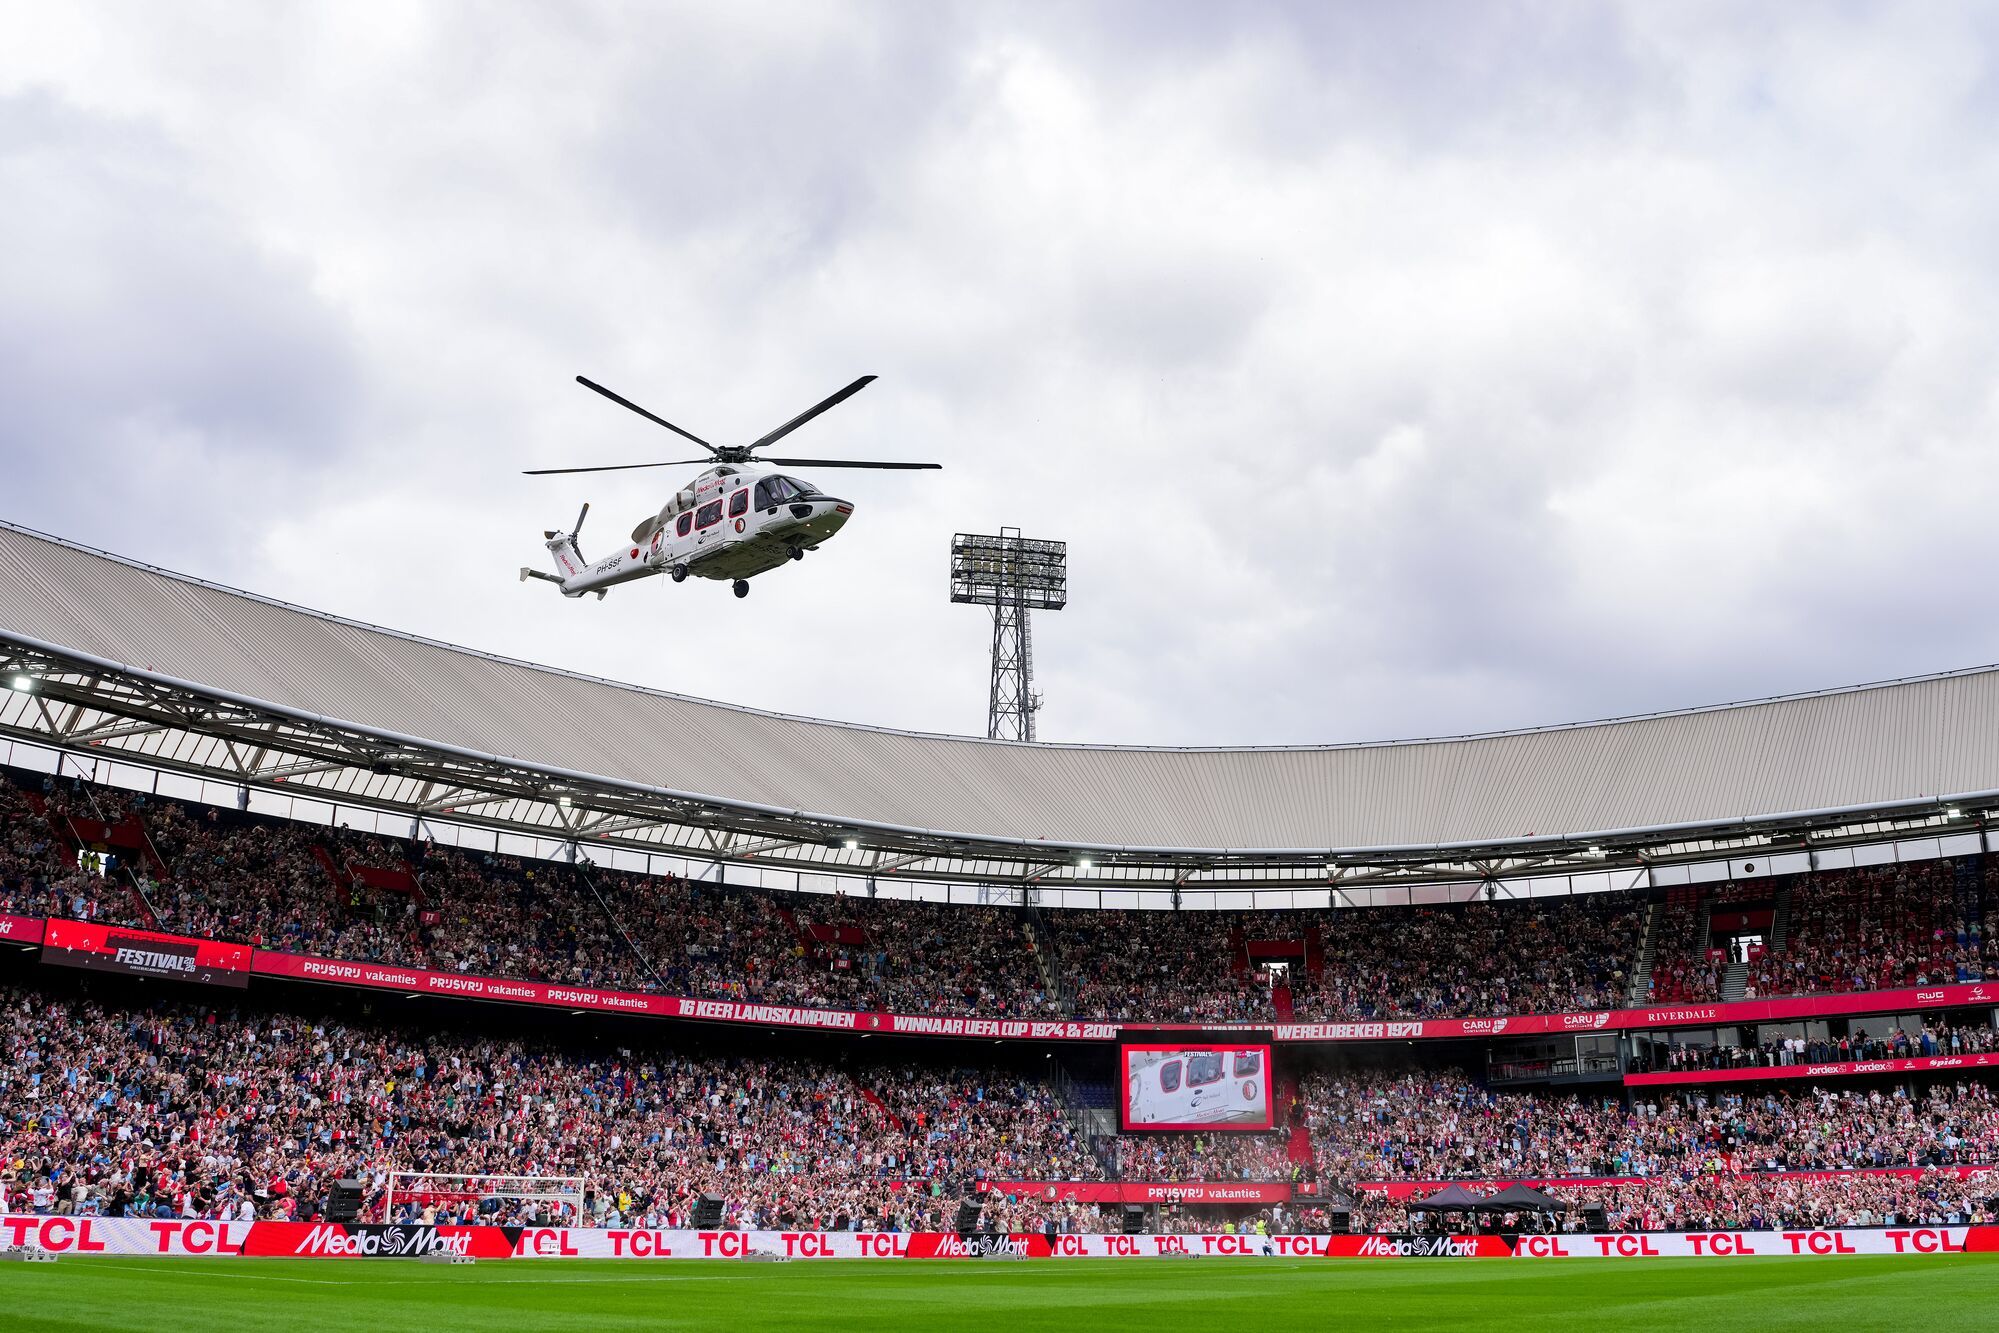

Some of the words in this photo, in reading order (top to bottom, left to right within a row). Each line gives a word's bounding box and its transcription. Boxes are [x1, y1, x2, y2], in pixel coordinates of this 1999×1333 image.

[597, 556, 622, 575] PH-SSF
[115, 948, 185, 971] FESTIVAL
[183, 957, 195, 965] 20
[365, 971, 417, 985] vakanties
[487, 985, 536, 998] vakanties
[1917, 991, 1944, 1000] RWG
[602, 997, 648, 1009] vakanties
[679, 1000, 694, 1015] 16
[695, 1001, 733, 1019] KEER
[734, 1005, 856, 1028] LANDSKAMPIOEN
[1564, 1015, 1592, 1025] CARU
[1648, 1010, 1716, 1022] RIVERDALE
[893, 1016, 963, 1034] WINNAAR
[964, 1019, 999, 1036] UEFA
[1001, 1022, 1028, 1037] CUP
[1031, 1022, 1064, 1037] 1974
[1067, 1024, 1080, 1038] &
[1277, 1023, 1384, 1040] WERELDBEKER
[1385, 1022, 1423, 1037] 1970
[1463, 1020, 1491, 1029] CARU
[1807, 1065, 1839, 1075] Jordex
[1853, 1062, 1886, 1072] Jordex
[1929, 1058, 1962, 1067] Spido
[1208, 1187, 1261, 1198] vakanties
[1304, 1184, 1310, 1192] V
[3, 1217, 105, 1251] TCL
[150, 1221, 242, 1254] TCL
[294, 1225, 382, 1254] Media
[402, 1226, 472, 1255] Markt
[515, 1229, 578, 1256] TCL
[608, 1231, 671, 1256] TCL
[1783, 1232, 1856, 1255] TCL
[1885, 1230, 1966, 1253] TCL
[698, 1232, 757, 1257] TCL
[781, 1233, 834, 1257] TCL
[856, 1234, 906, 1257] TCL
[934, 1235, 979, 1256] Media
[991, 1235, 1029, 1256] Markt
[1052, 1235, 1089, 1256] TCL
[1104, 1235, 1140, 1255] TCL
[1154, 1235, 1189, 1254] TCL
[1202, 1236, 1254, 1254] TCL
[1275, 1236, 1326, 1256] TCL
[1358, 1236, 1412, 1257] Media
[1427, 1236, 1478, 1257] Markt
[1513, 1236, 1569, 1257] TCL
[1594, 1235, 1659, 1257] TCL
[1686, 1234, 1755, 1256] TCL
